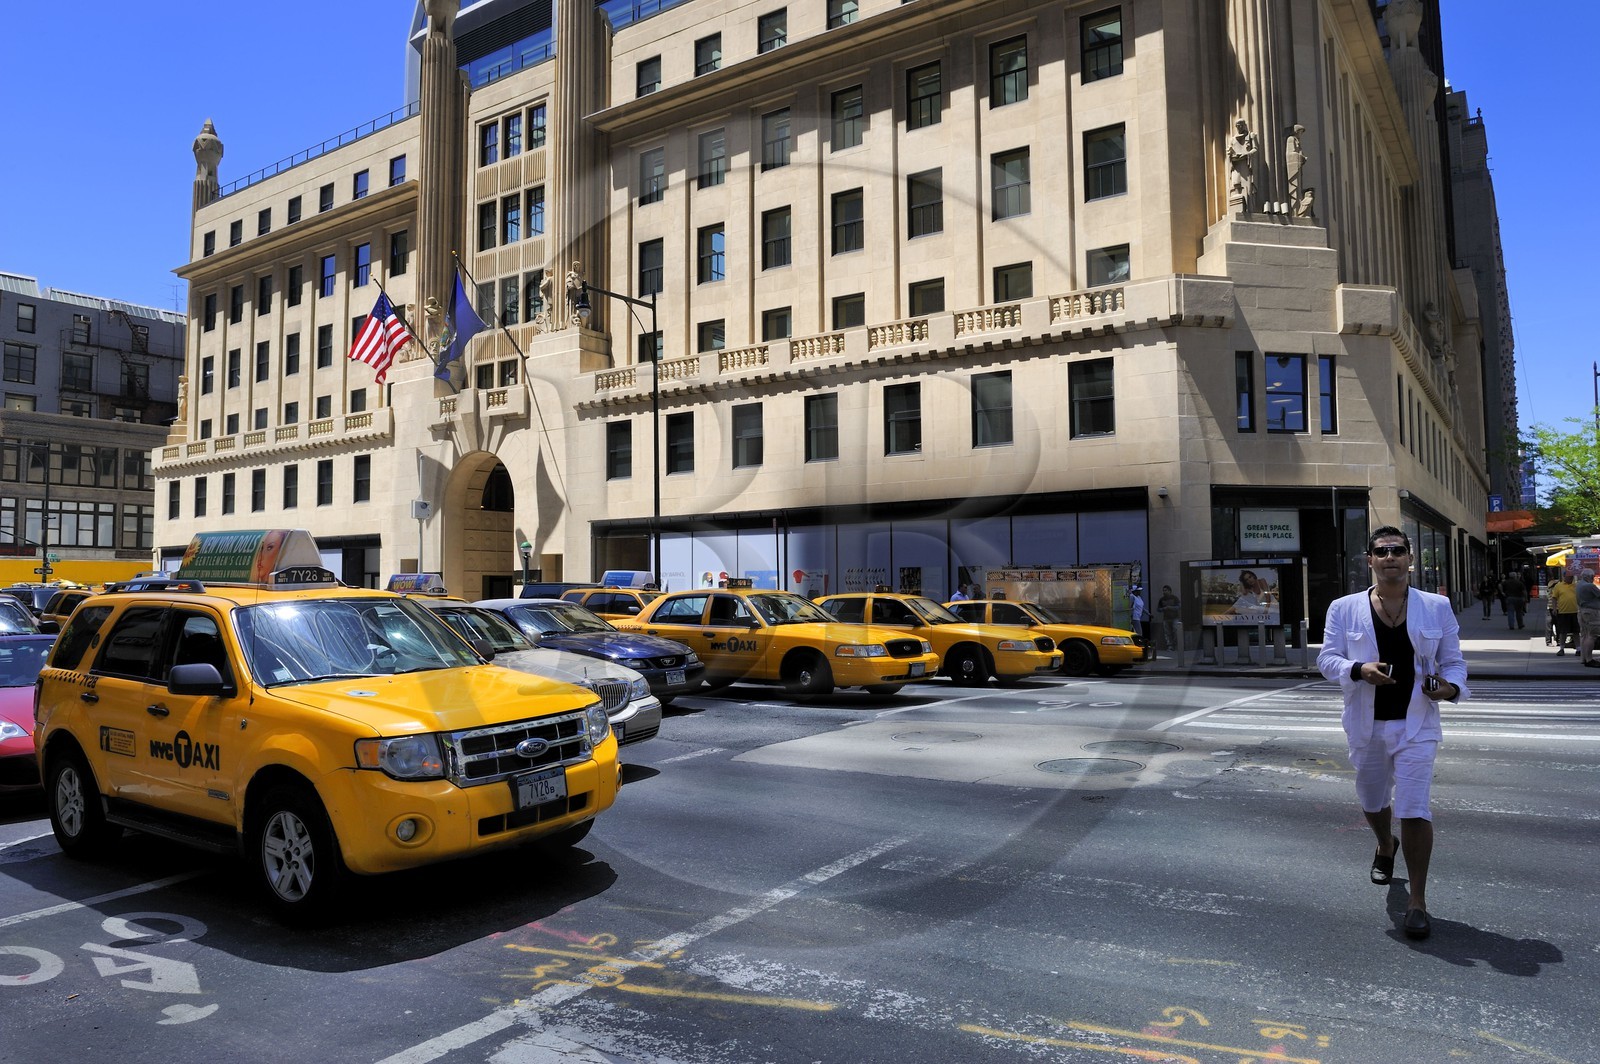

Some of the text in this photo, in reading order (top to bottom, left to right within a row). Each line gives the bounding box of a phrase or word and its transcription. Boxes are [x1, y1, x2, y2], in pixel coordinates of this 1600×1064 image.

[200, 536, 221, 553] NEW
[215, 535, 240, 553] YORK
[232, 534, 262, 553] DOLLS
[194, 555, 251, 566] GENTLEMEN'S CLUB
[291, 570, 318, 582] 7Y28
[710, 636, 757, 652] NYC TAXI
[79, 674, 99, 689] 7Y28
[150, 739, 174, 761] NYC
[174, 730, 220, 771] TAXI
[527, 742, 543, 752] Ford
